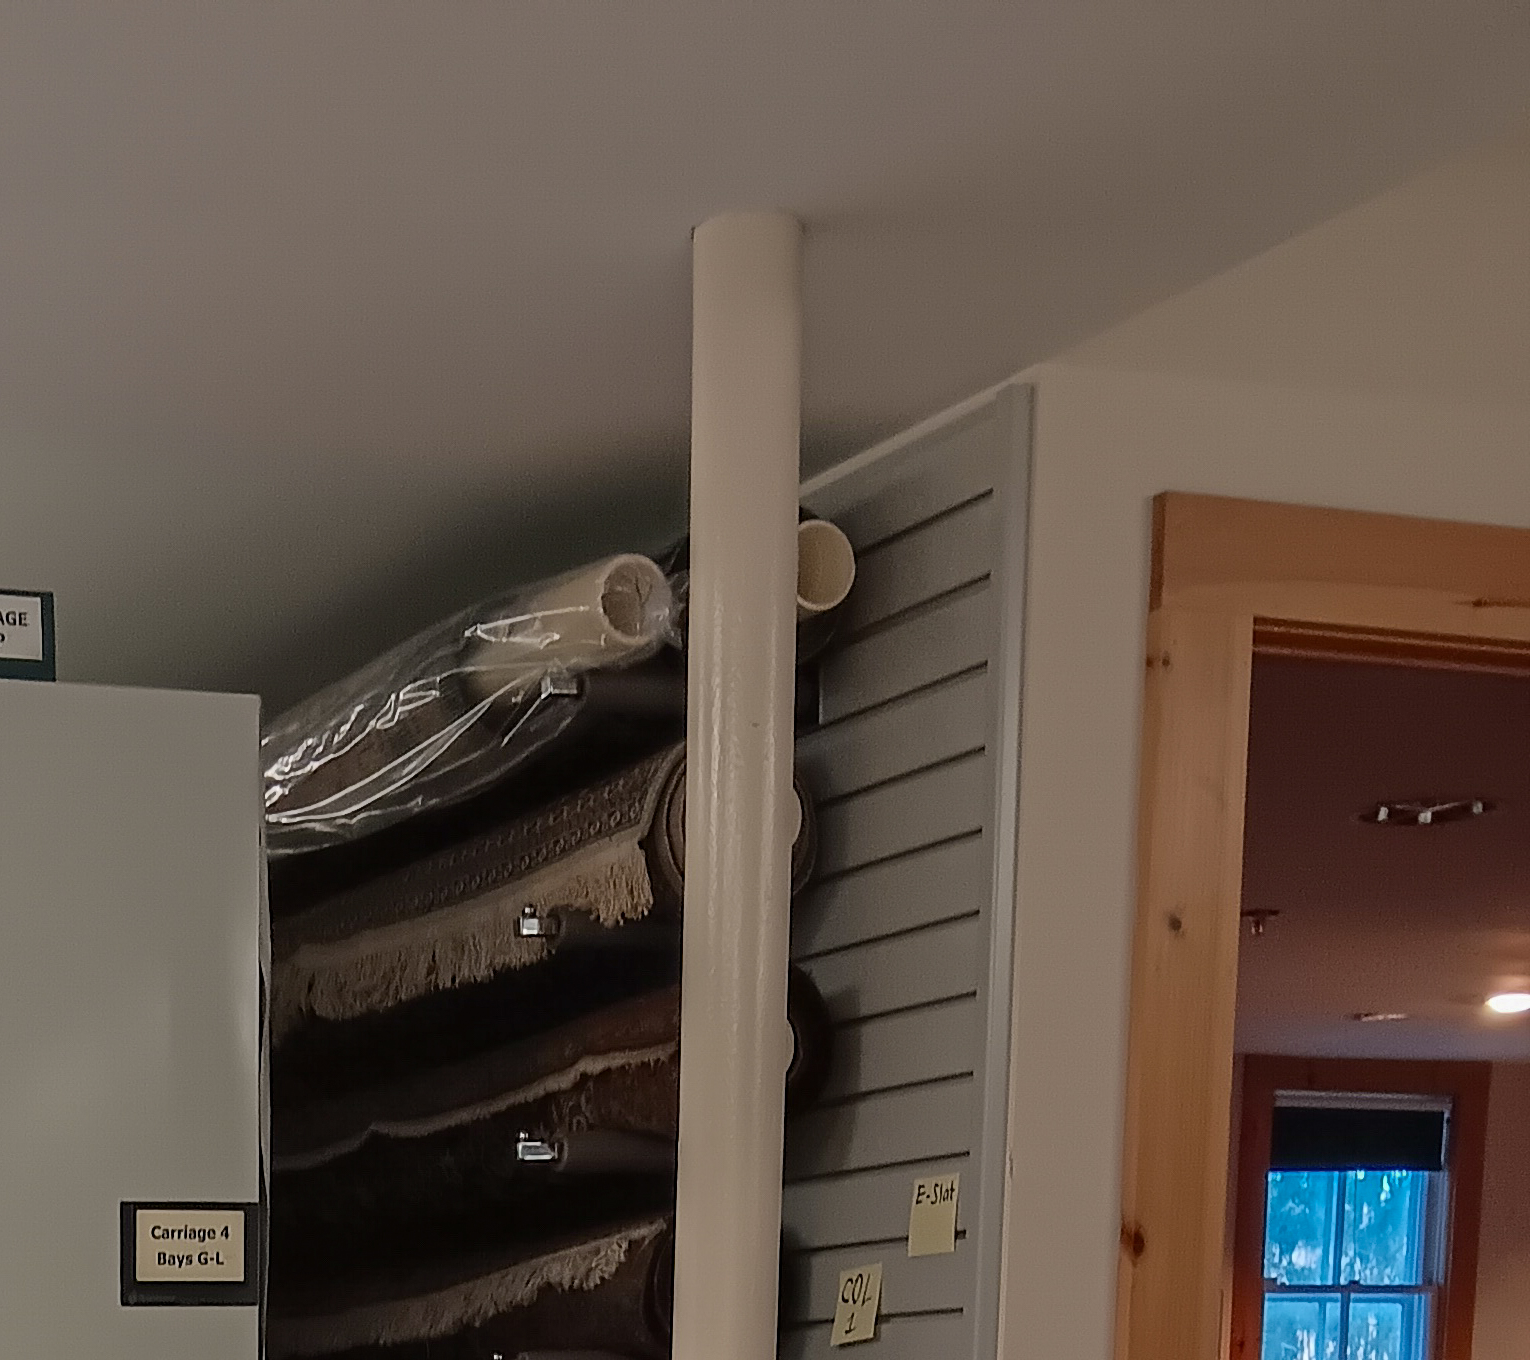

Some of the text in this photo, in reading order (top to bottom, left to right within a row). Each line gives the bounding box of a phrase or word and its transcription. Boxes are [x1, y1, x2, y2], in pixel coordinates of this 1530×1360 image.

[151, 1224, 230, 1243] Carriage 4
[157, 1251, 225, 1269] Bays G-L
